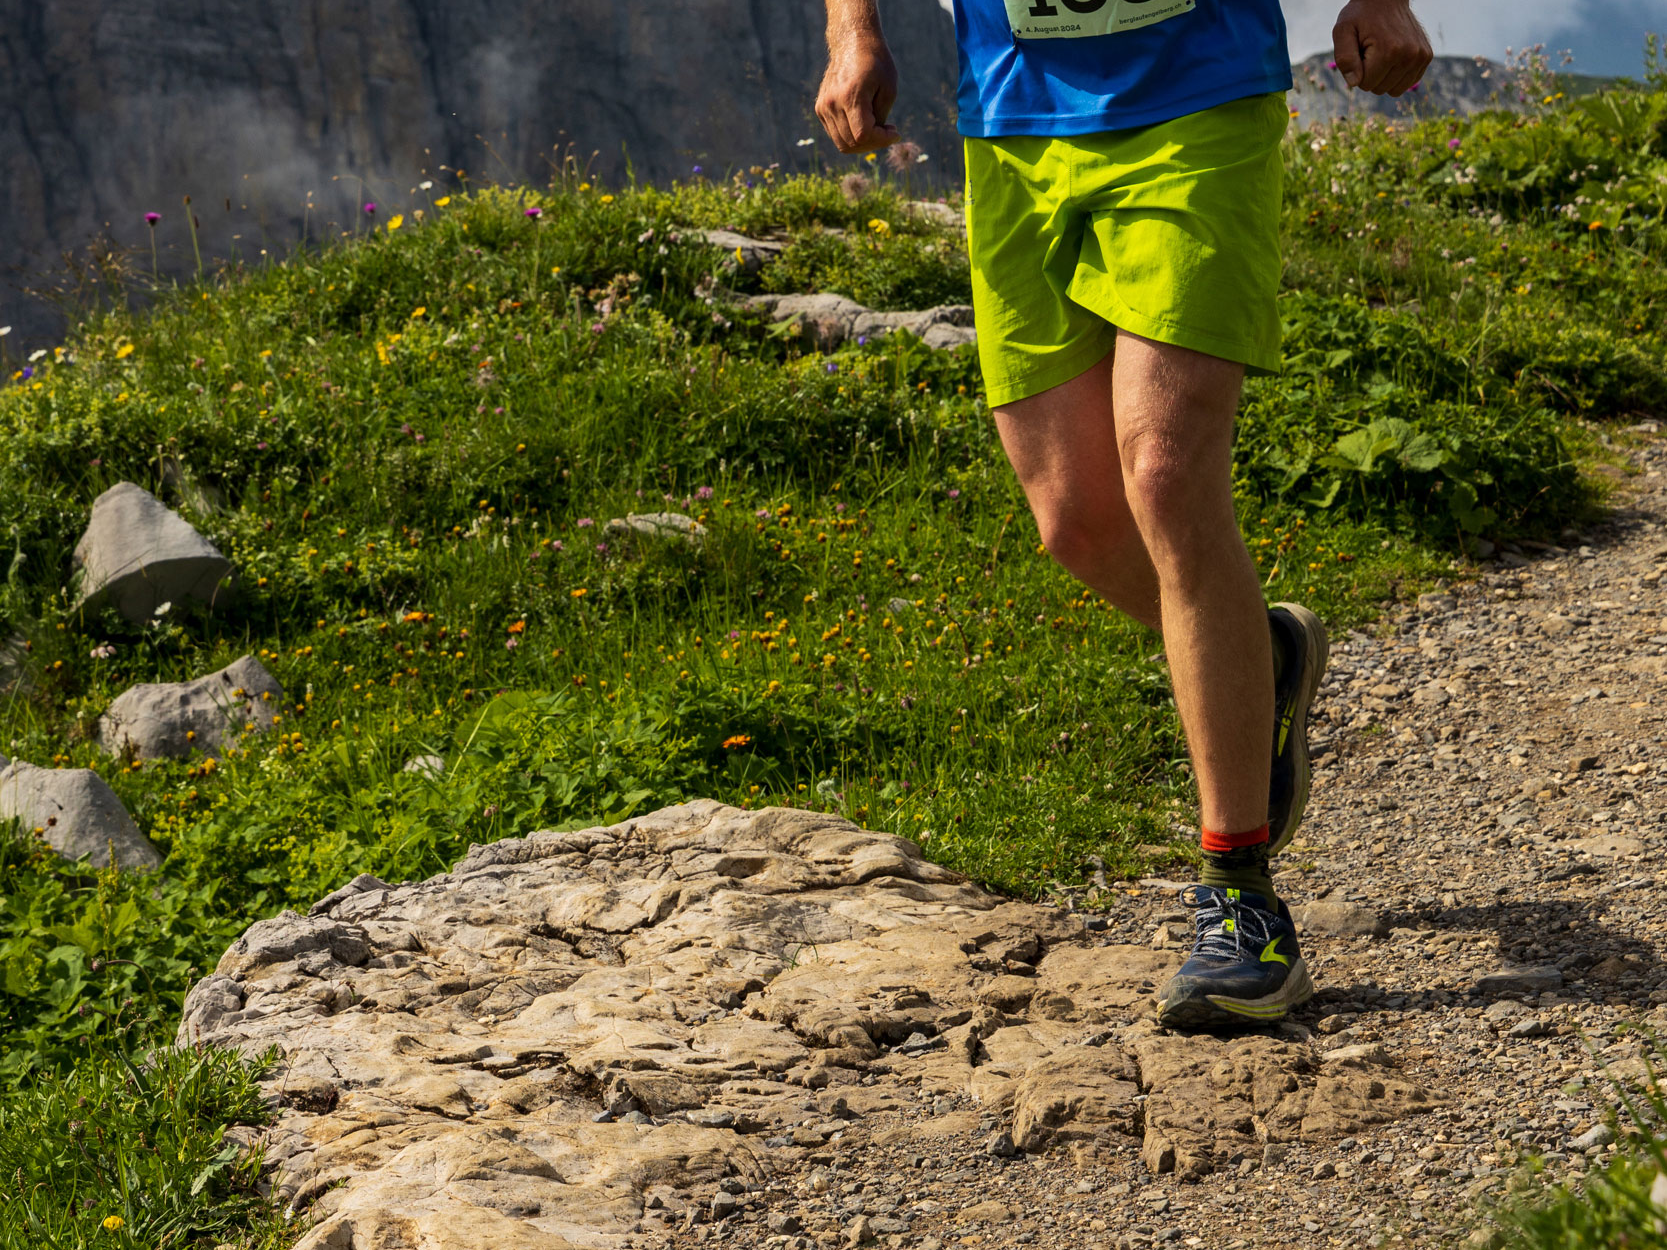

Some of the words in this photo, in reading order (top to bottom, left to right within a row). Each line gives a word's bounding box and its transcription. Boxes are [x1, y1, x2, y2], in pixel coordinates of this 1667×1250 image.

[1118, 3, 1182, 25] berglaufengelberg.ch
[1033, 26, 1060, 35] August
[1060, 24, 1081, 32] 2024
